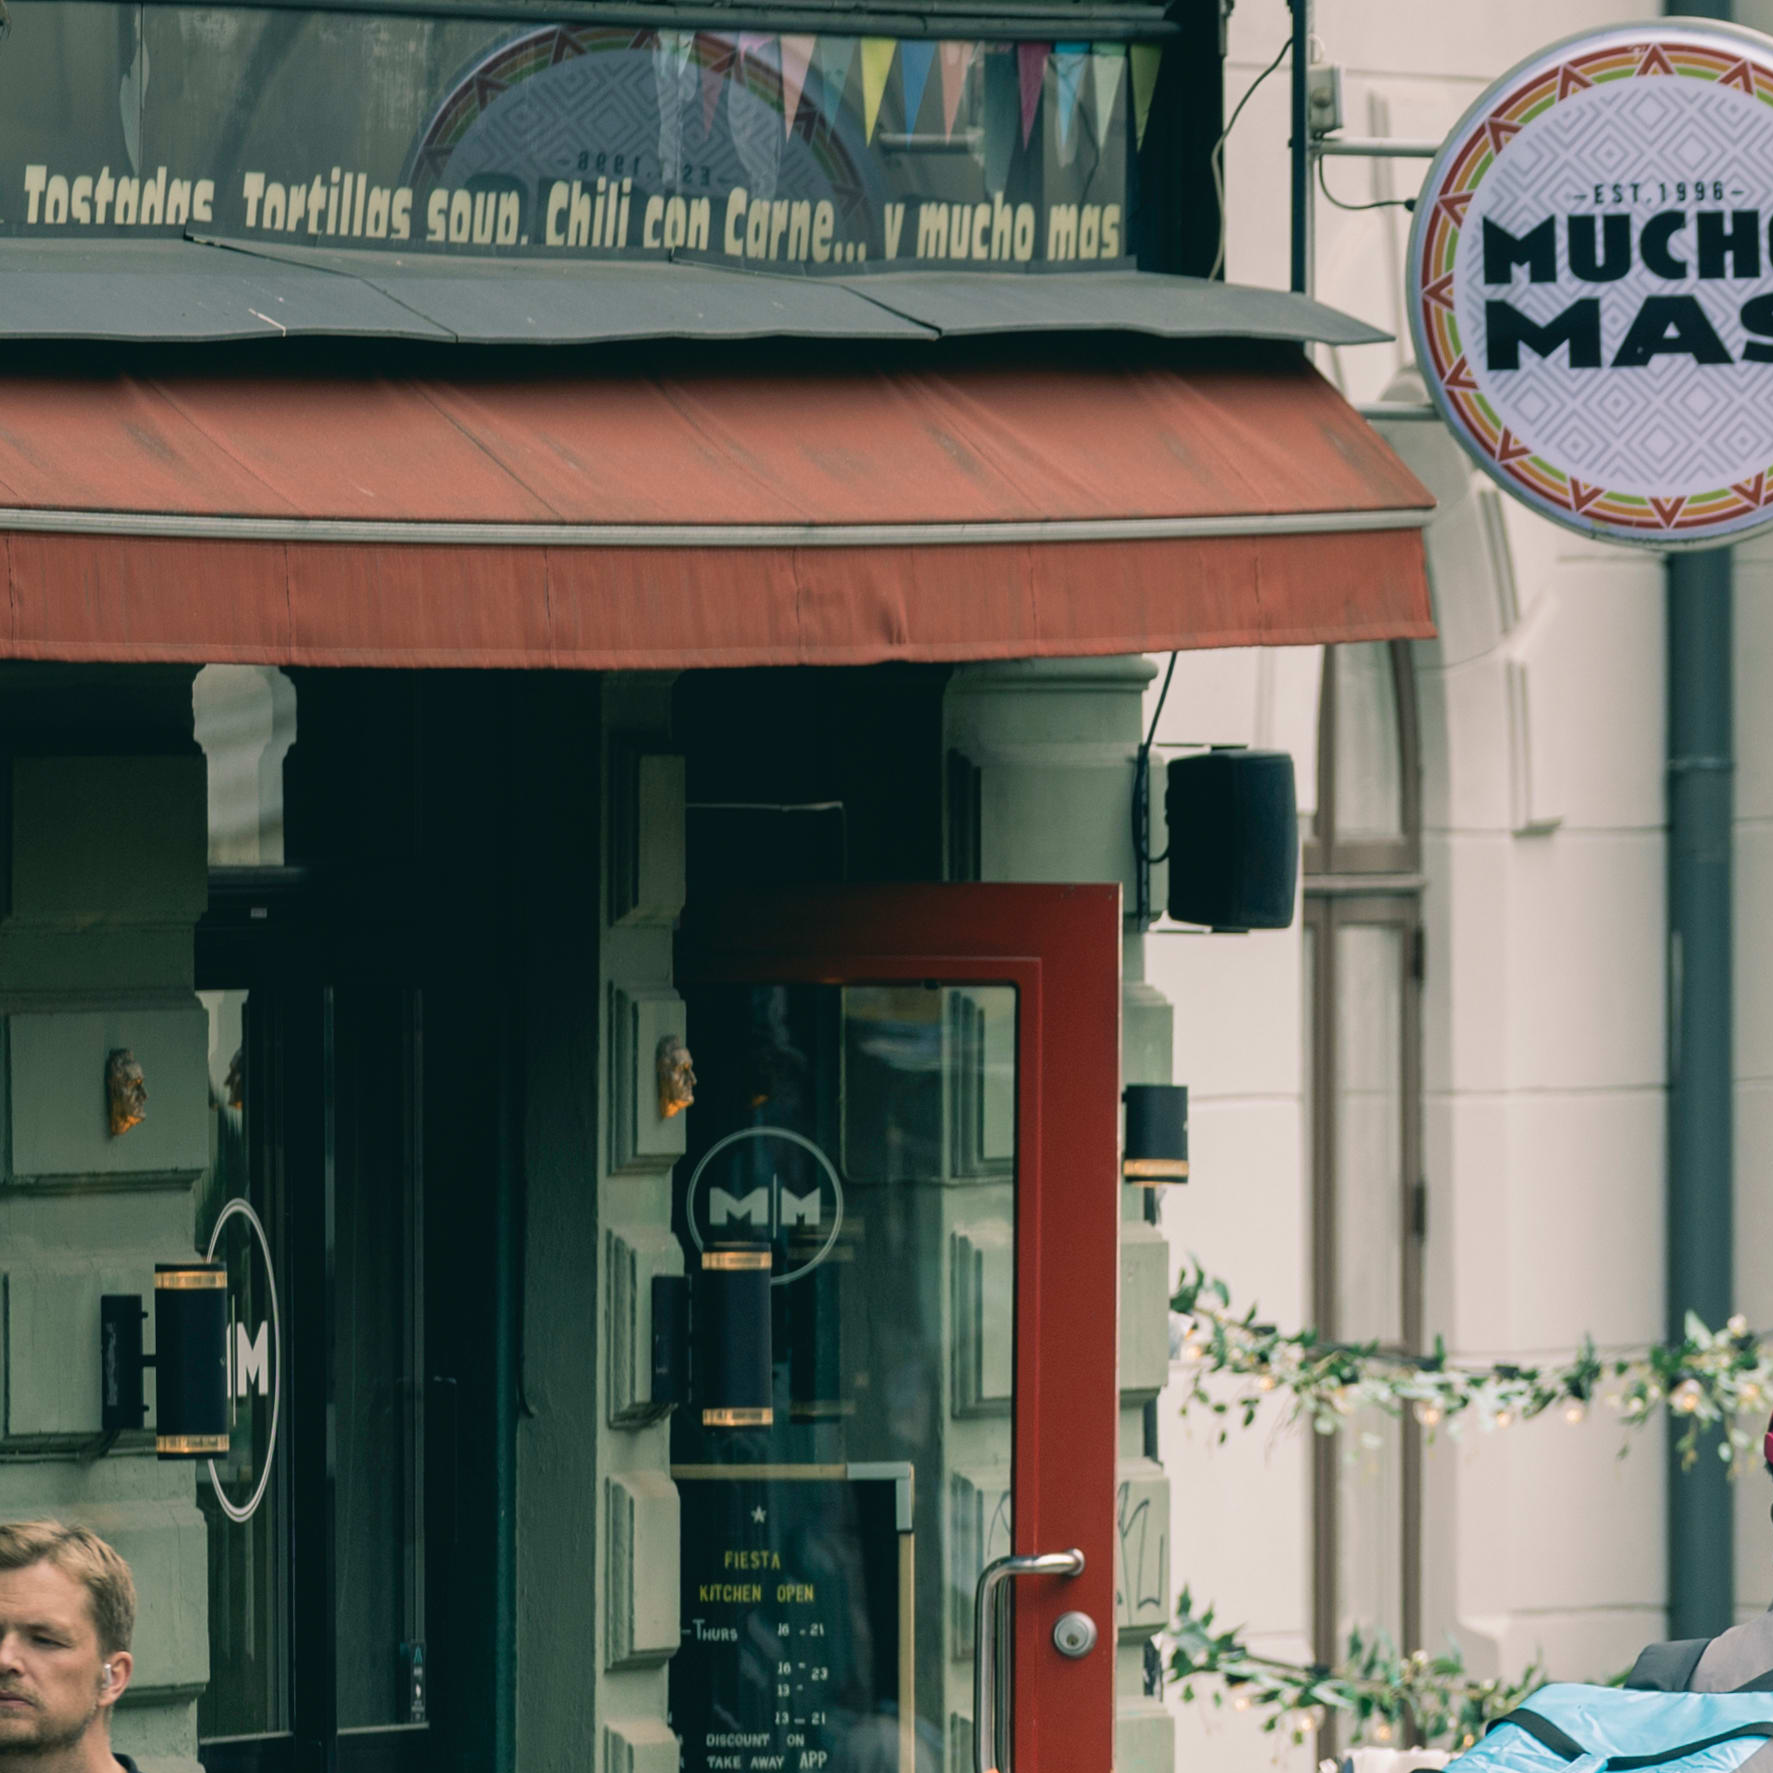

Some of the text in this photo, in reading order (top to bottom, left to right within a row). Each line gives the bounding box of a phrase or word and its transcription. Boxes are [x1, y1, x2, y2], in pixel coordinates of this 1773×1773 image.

[243, 166, 413, 240] Tortillas
[546, 176, 632, 249] Chili
[643, 193, 711, 250] con
[916, 190, 1034, 262] mucho
[1047, 201, 1122, 262] mas
[724, 1550, 781, 1570] FIESTA
[700, 1583, 815, 1603] KITCHEN OPEN
[706, 1734, 805, 1748] DISCOUNT ON
[706, 1751, 828, 1769] TAKE AWAY APP
